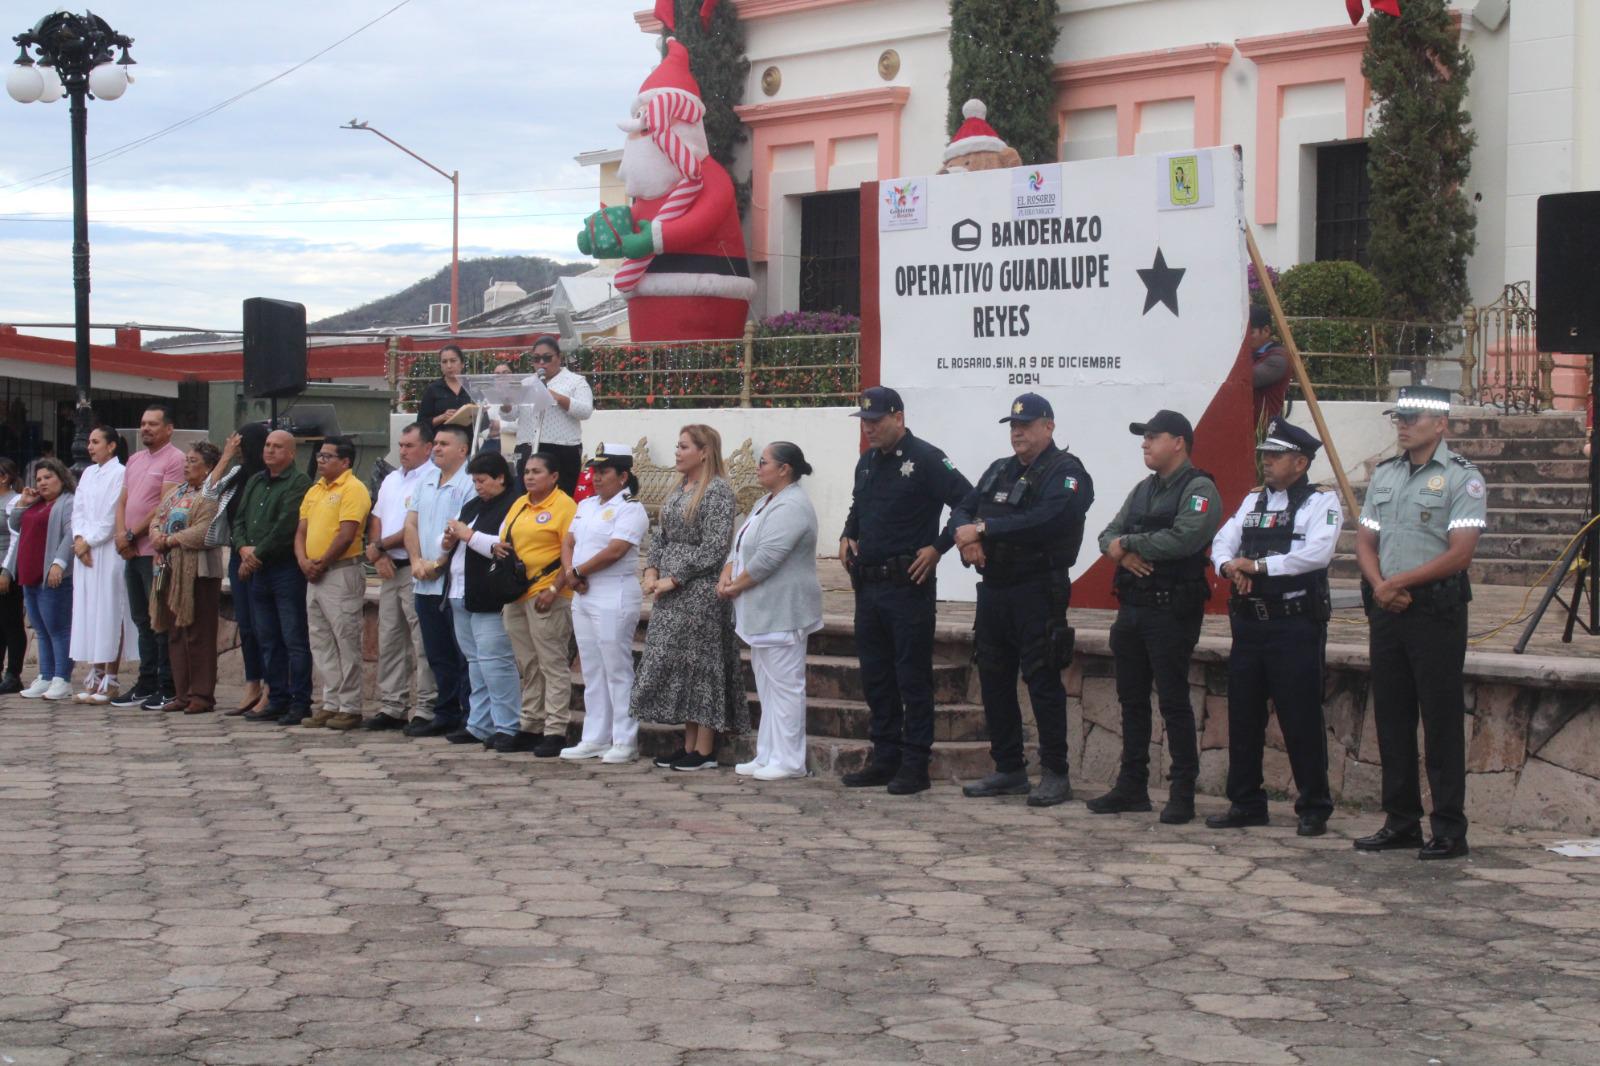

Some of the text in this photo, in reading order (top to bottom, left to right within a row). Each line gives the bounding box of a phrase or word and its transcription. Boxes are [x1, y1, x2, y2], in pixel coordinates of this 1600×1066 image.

[991, 215, 1102, 247] BANDERAZO
[895, 254, 1109, 296] OPERATIVO GUADALUPE
[973, 304, 1030, 338] REYES
[937, 357, 949, 369] EL
[1019, 356, 1026, 369] A
[1029, 356, 1037, 369] 9
[1041, 356, 1054, 369] DE
[1058, 356, 1121, 369] DICIEMBRE
[1008, 373, 1040, 385] 2024
